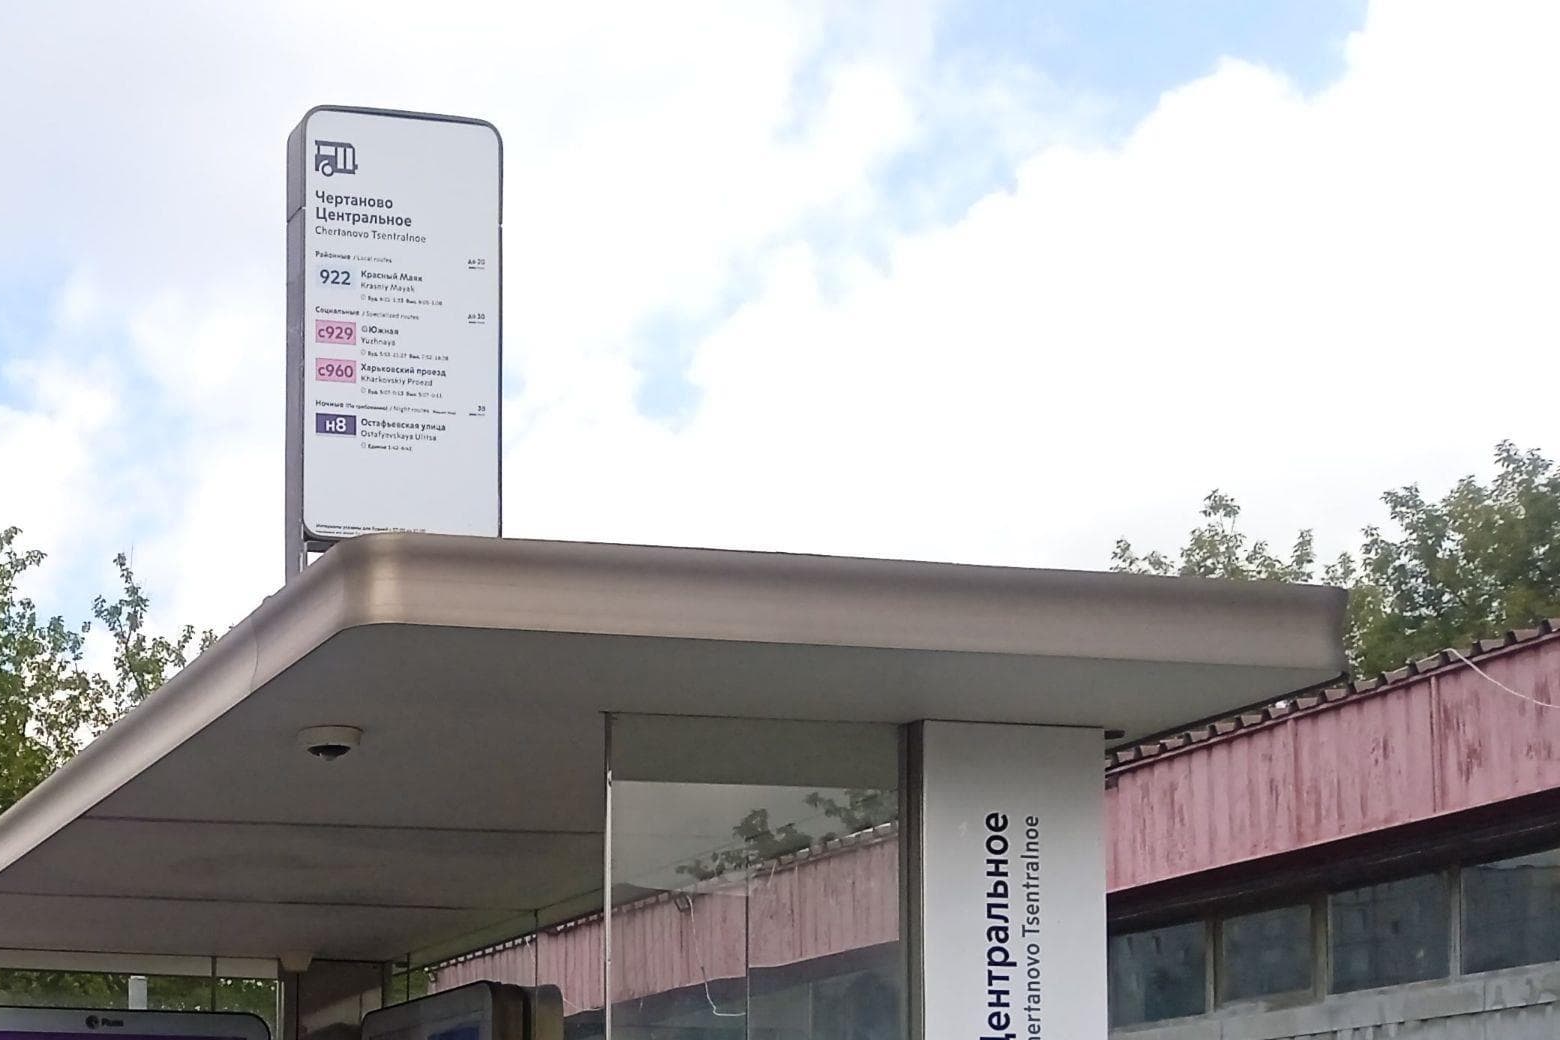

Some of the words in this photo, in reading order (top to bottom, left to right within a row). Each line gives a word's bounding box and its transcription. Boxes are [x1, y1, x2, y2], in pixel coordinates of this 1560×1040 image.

[315, 190, 394, 209] Чертаново
[315, 207, 413, 227] Центральное
[315, 226, 369, 239] Chertanovo
[372, 231, 427, 244] Tsentralnoe
[320, 269, 351, 286] 922
[360, 270, 398, 282] Красный
[400, 272, 423, 282] Маяк
[368, 326, 400, 336] Южная
[360, 362, 414, 374] Харьковский
[416, 368, 446, 377] проезд
[360, 418, 420, 430] Остафьевская
[421, 423, 446, 434] улица
[1020, 815, 1040, 937] Tsentralnoe
